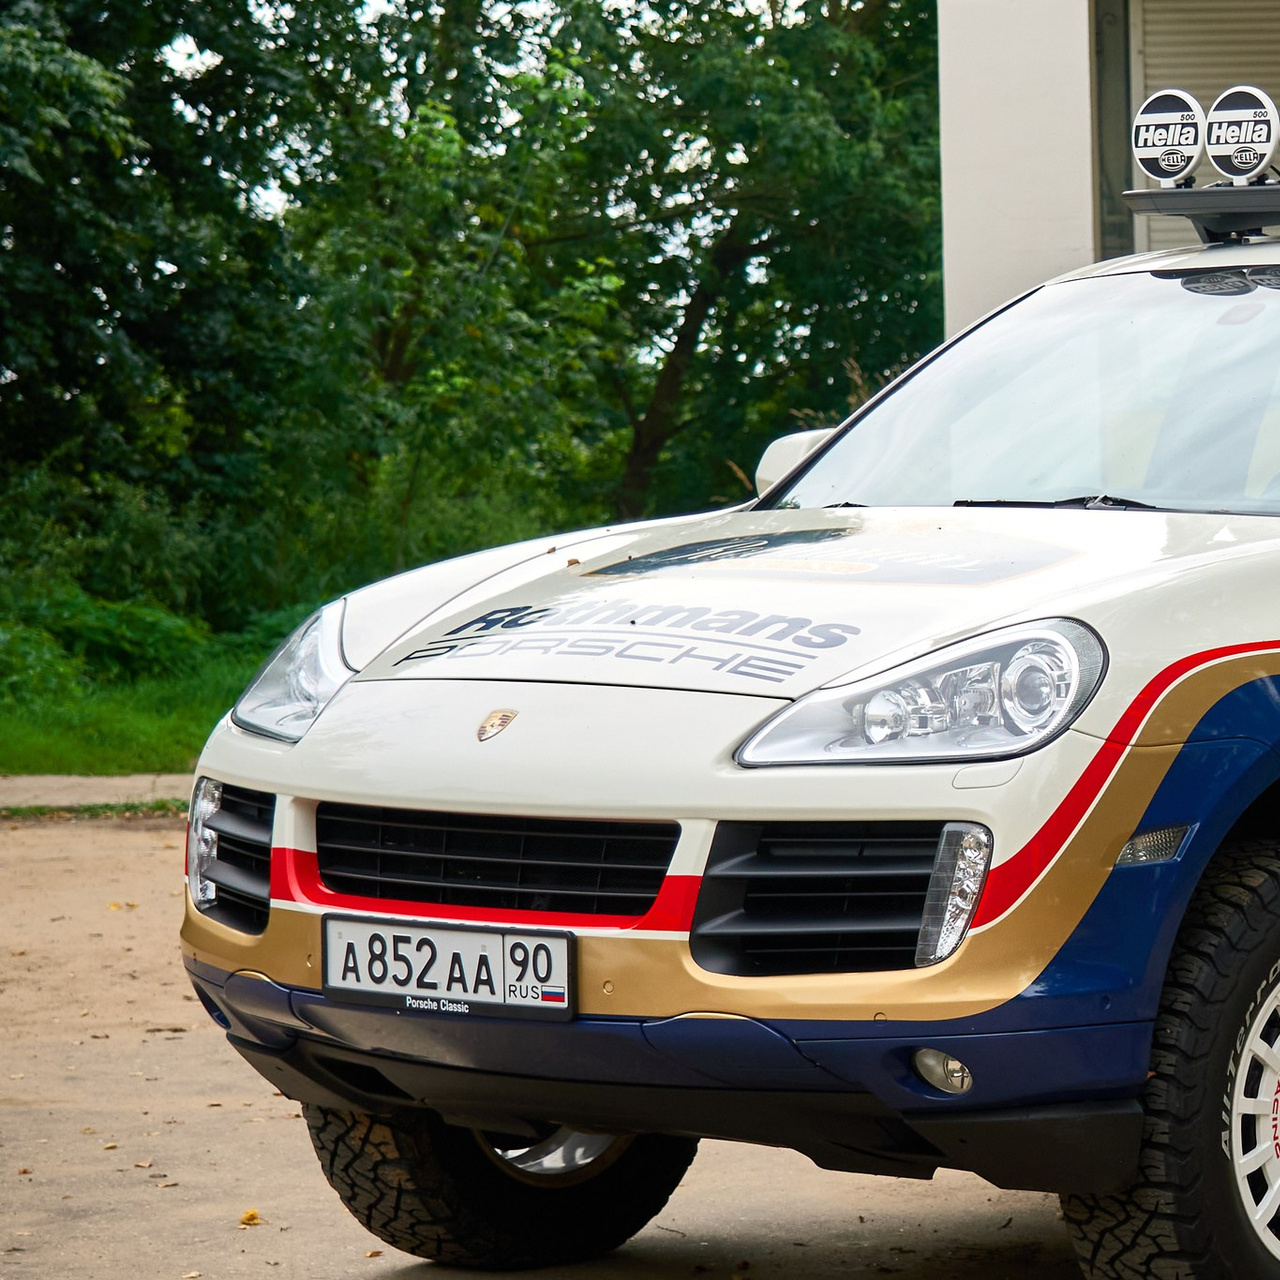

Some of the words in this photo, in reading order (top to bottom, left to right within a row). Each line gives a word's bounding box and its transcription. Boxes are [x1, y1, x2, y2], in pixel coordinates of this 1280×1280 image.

[1179, 113, 1196, 122] 500
[1252, 110, 1269, 119] 500
[1137, 124, 1197, 147] Hella
[1210, 121, 1269, 145] Hella
[1161, 154, 1186, 165] HELLA
[1234, 152, 1259, 163] HELLA
[444, 597, 861, 650] Rothmans
[392, 637, 817, 683] PORSCHE
[509, 941, 553, 983] 90
[508, 984, 540, 999] RUS
[406, 995, 438, 1011] Porsche
[440, 1001, 470, 1013] Classic
